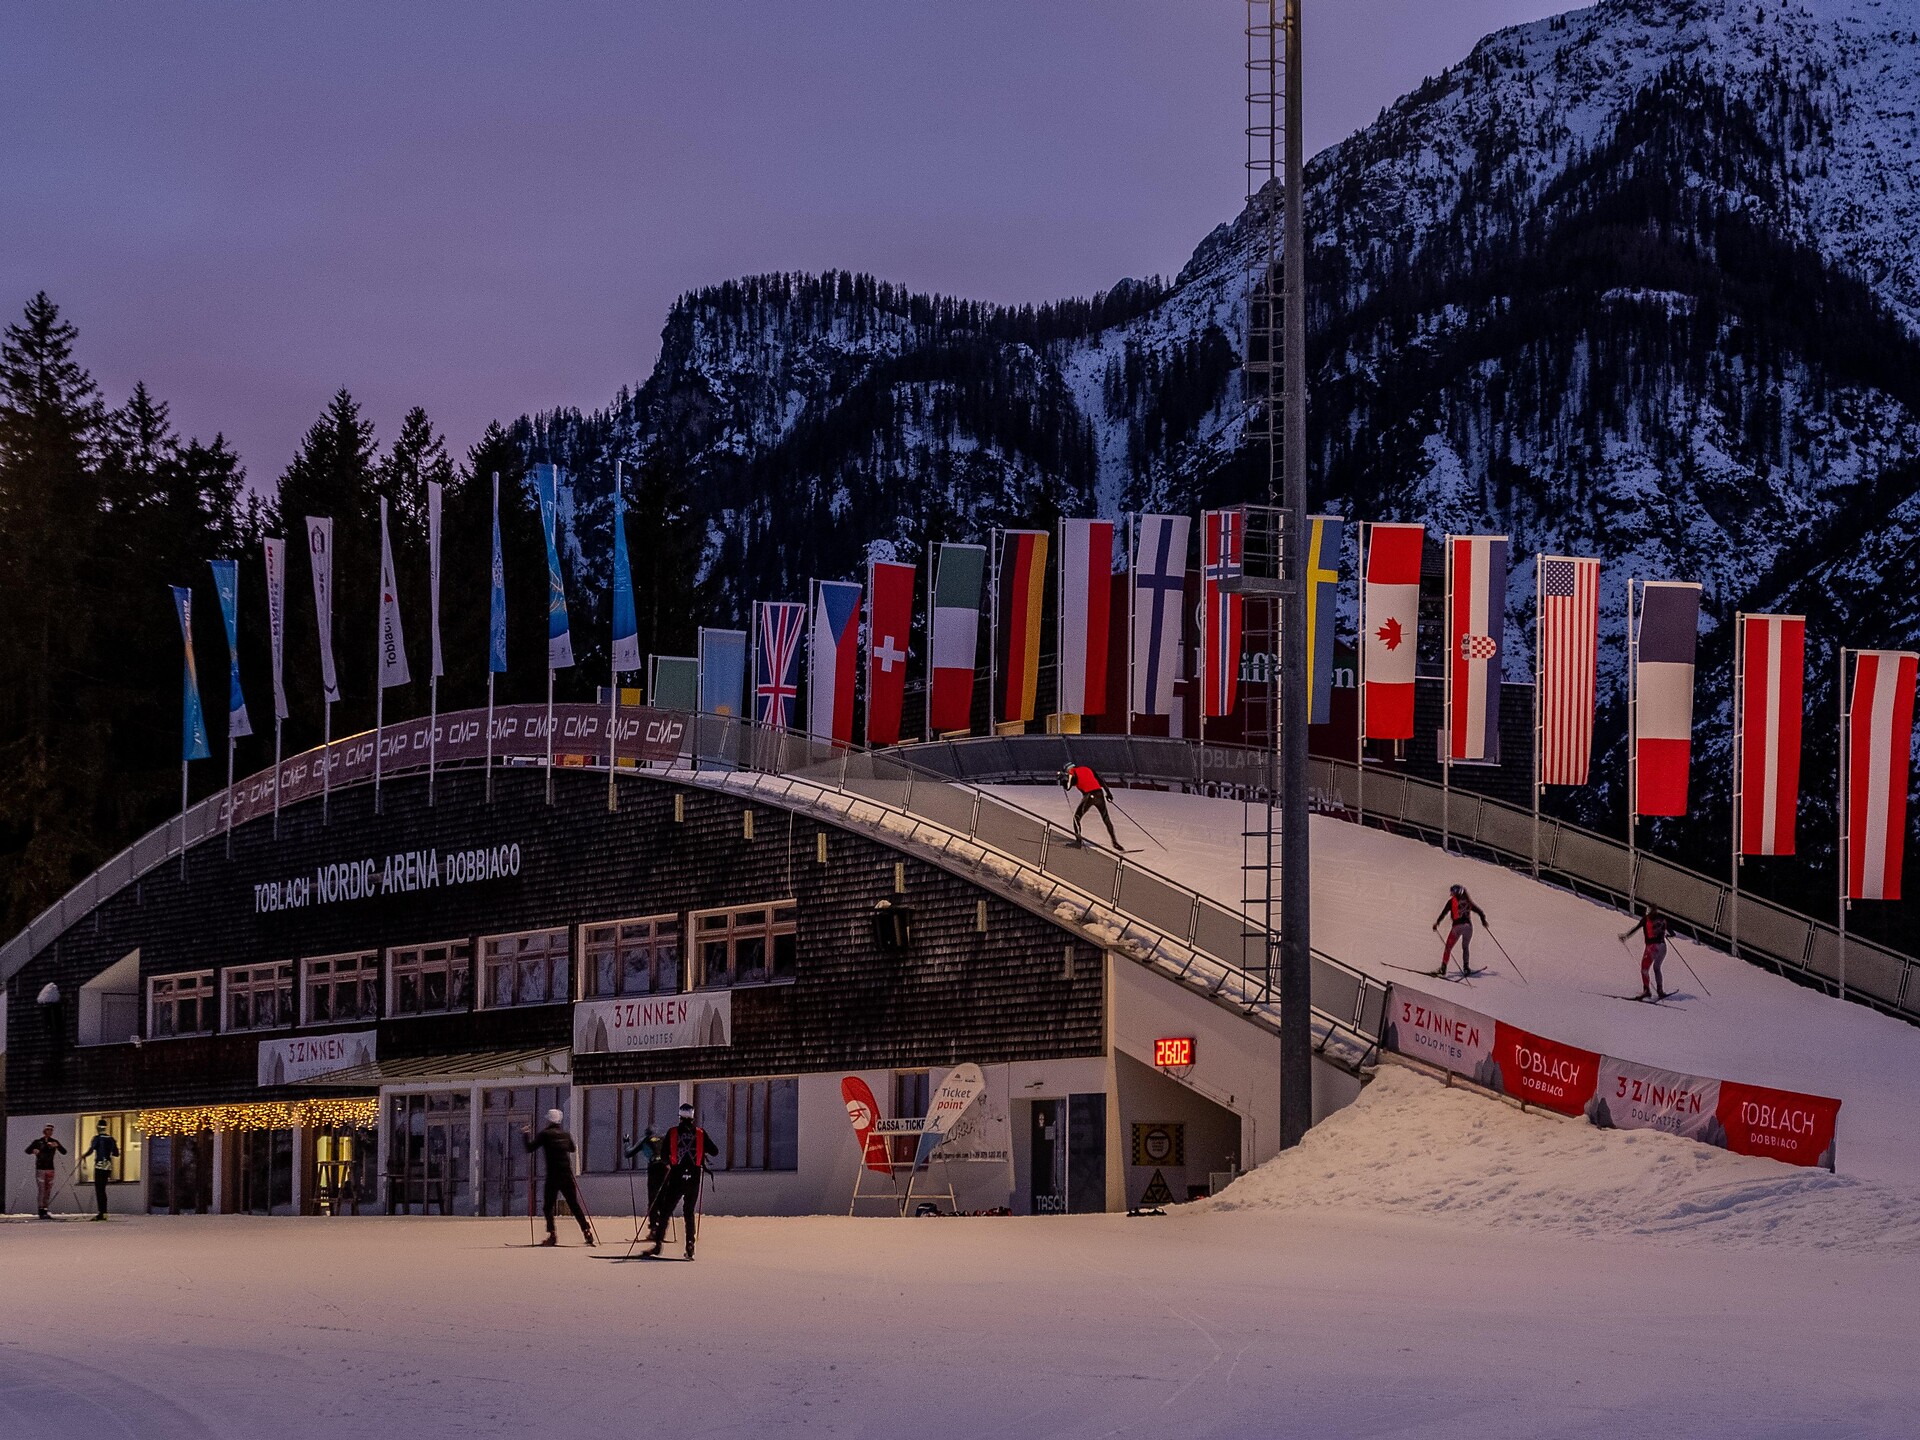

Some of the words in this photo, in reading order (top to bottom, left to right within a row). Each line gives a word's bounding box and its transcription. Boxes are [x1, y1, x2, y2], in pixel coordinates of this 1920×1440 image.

[250, 778, 276, 803] CMP
[281, 765, 307, 789] CMP
[346, 742, 373, 767] CMP
[380, 735, 407, 758] CMP
[414, 727, 442, 750] CMP
[449, 721, 479, 743] CMP
[486, 717, 517, 740] CMP
[524, 716, 558, 738] CMP
[564, 715, 598, 739] CMP
[605, 717, 639, 741] CMP
[645, 720, 682, 744] CMP
[254, 877, 310, 913] TOBLACH
[317, 858, 376, 905] NORDIC
[381, 848, 440, 895] ARENA
[446, 843, 520, 886] DOBBIACO
[627, 1033, 673, 1046] DOLOMITES
[1515, 1044, 1580, 1086] TOBLACH
[942, 1087, 972, 1099] Ticket
[1522, 1076, 1564, 1097] DOBBIACO
[937, 1100, 964, 1111] point
[877, 1119, 900, 1131] CASSA
[905, 1119, 925, 1130] TICKE
[1741, 1101, 1815, 1136] TOBLACH
[1750, 1132, 1798, 1150] DOBBIACO
